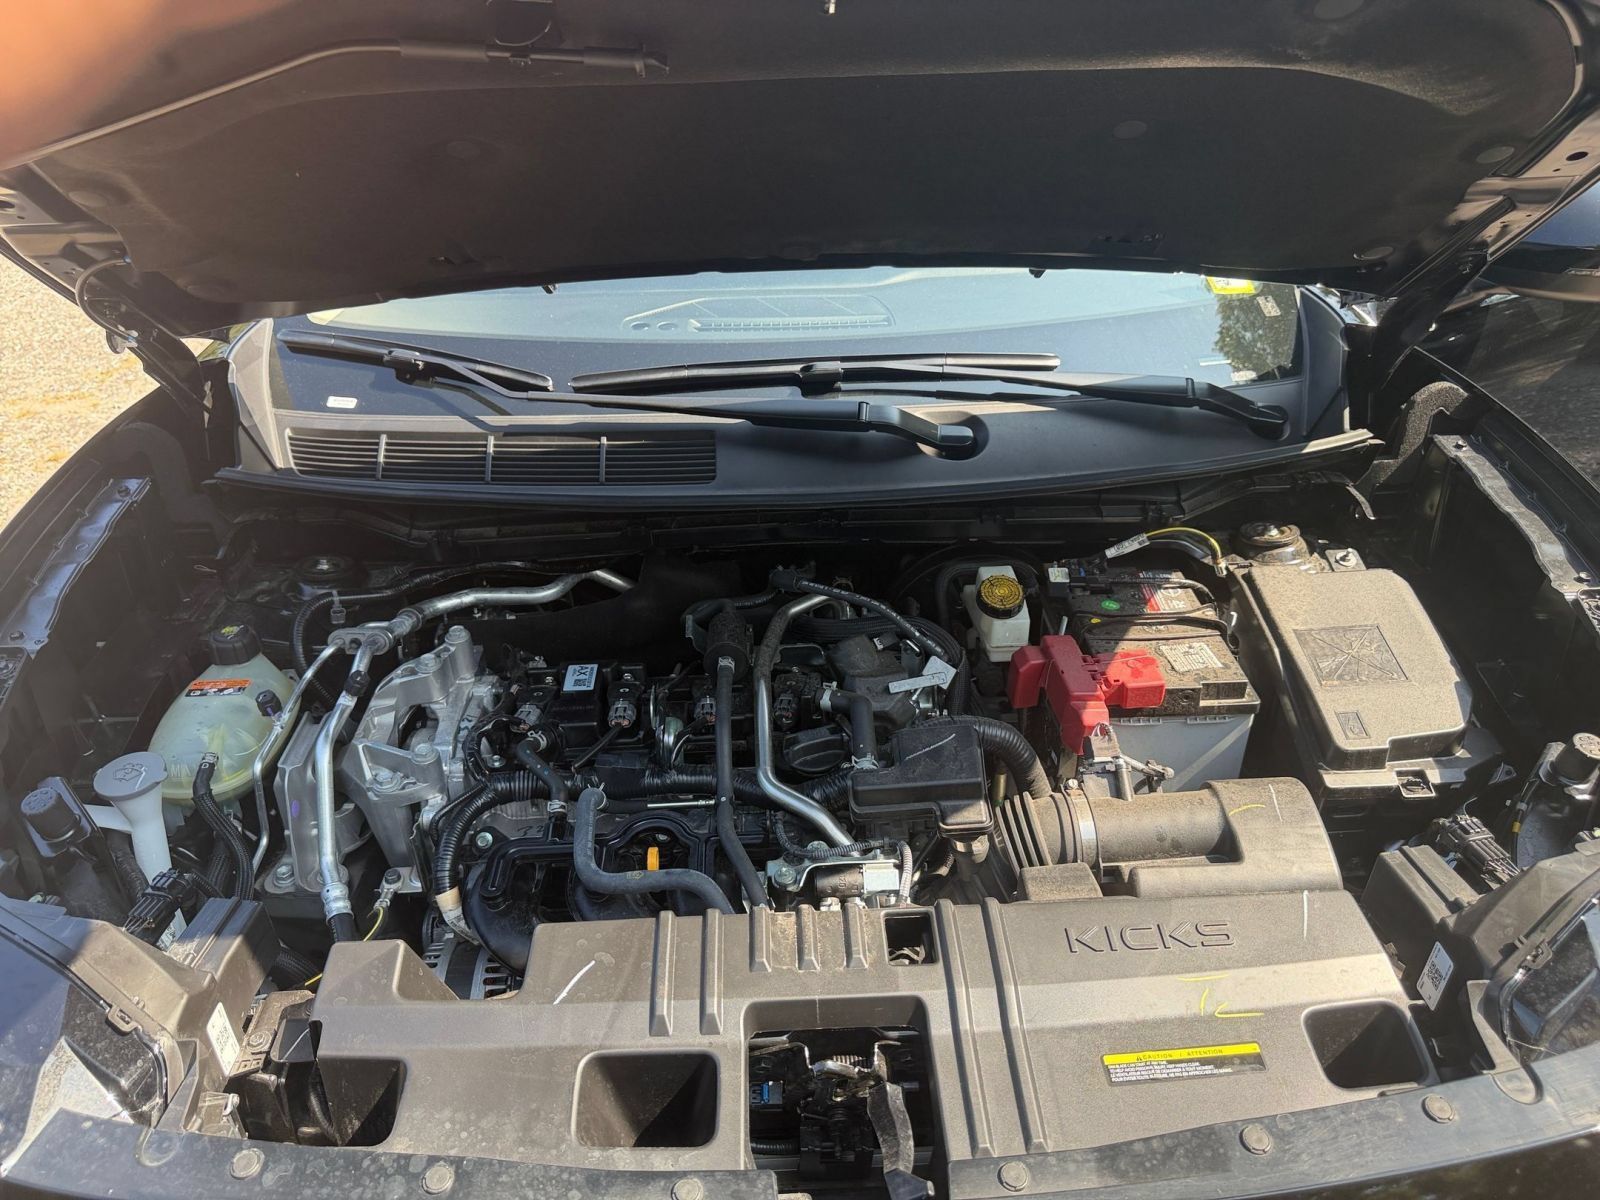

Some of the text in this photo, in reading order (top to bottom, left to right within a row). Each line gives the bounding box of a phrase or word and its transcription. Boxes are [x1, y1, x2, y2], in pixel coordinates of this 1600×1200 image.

[577, 666, 589, 677] AX
[1064, 920, 1235, 953] KICKS
[1187, 1049, 1223, 1057] ATTENTION
